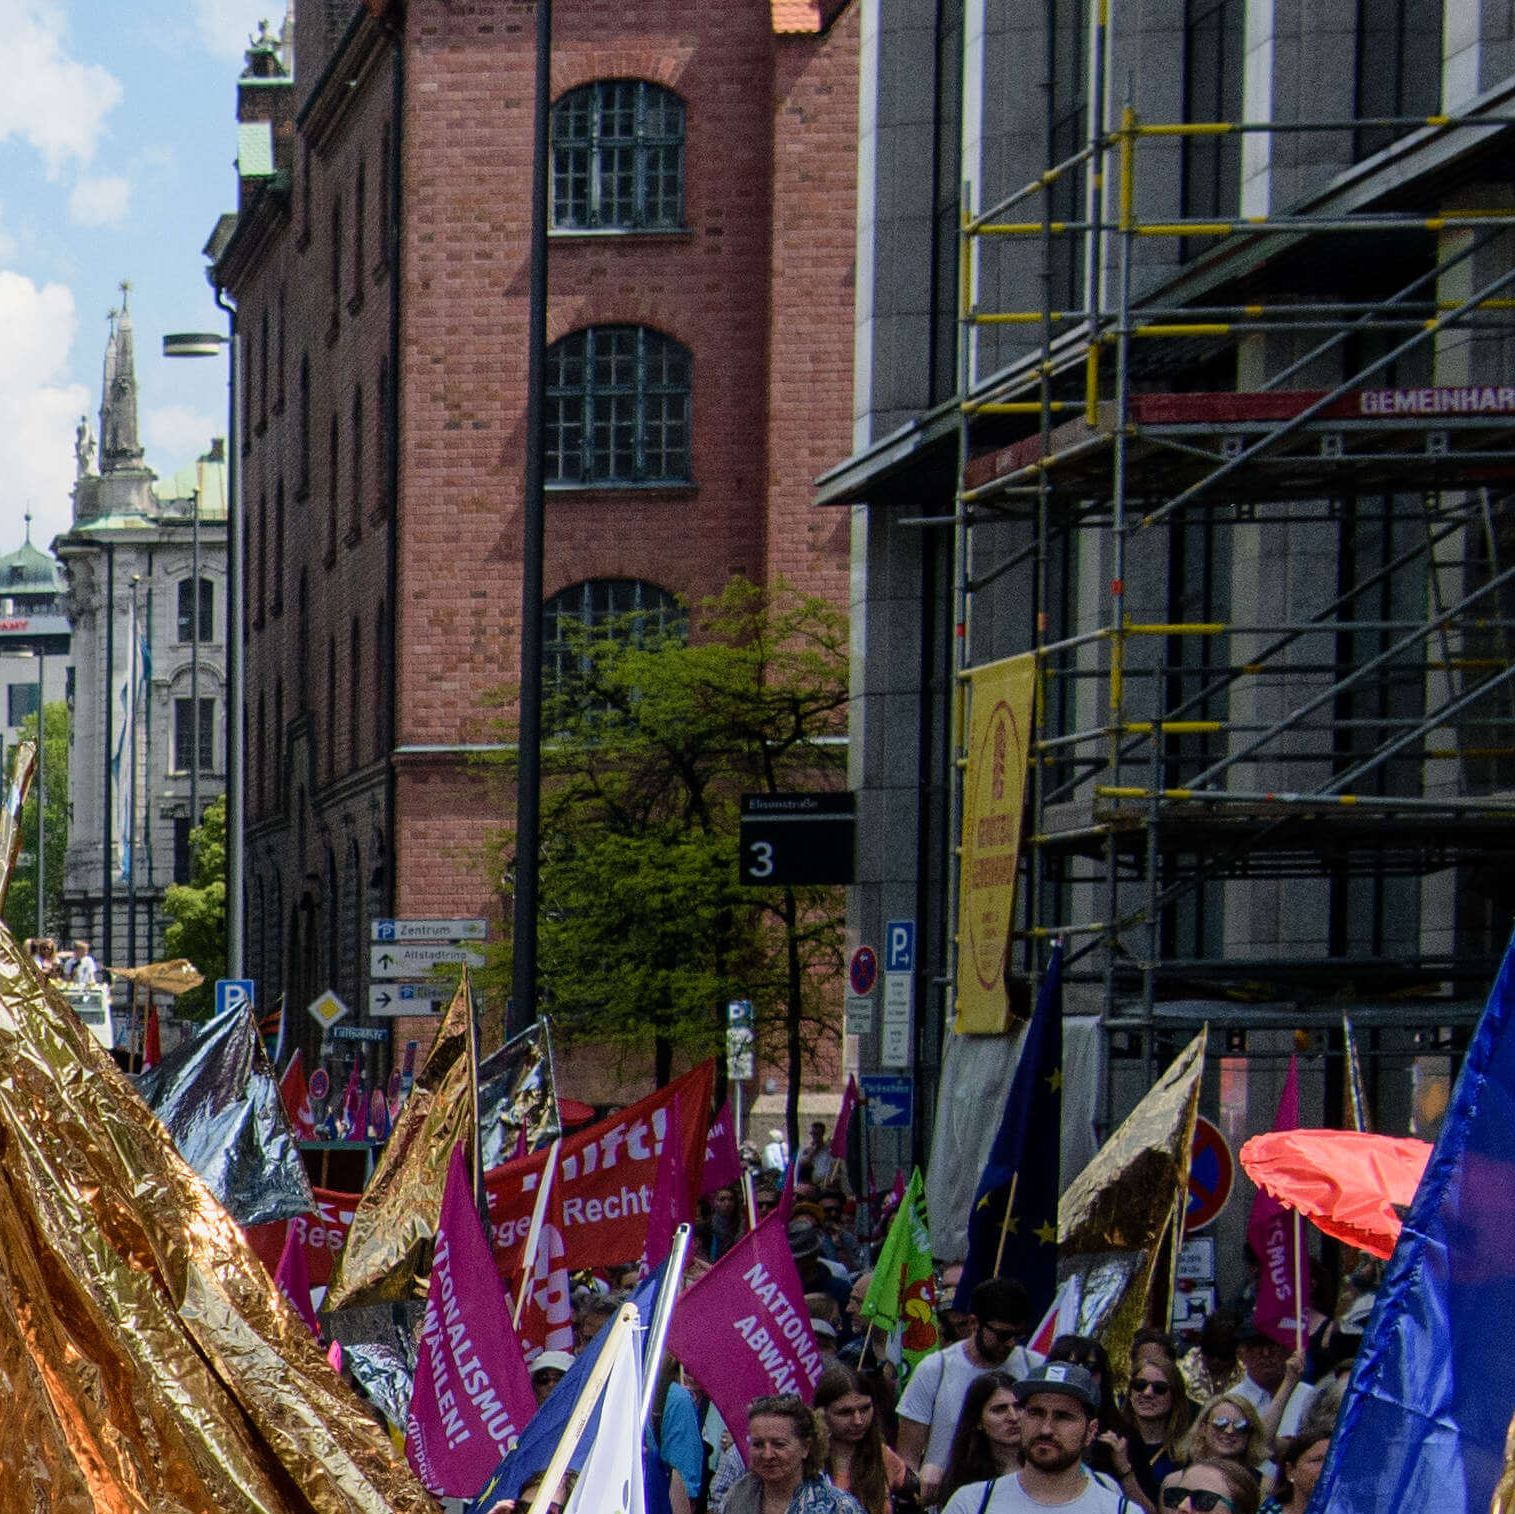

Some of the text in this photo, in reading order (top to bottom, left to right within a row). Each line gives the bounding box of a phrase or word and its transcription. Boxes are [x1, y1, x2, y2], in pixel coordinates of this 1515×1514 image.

[749, 841, 773, 877] 3
[400, 925, 451, 936] Zentrum
[563, 1186, 654, 1228] Recht
